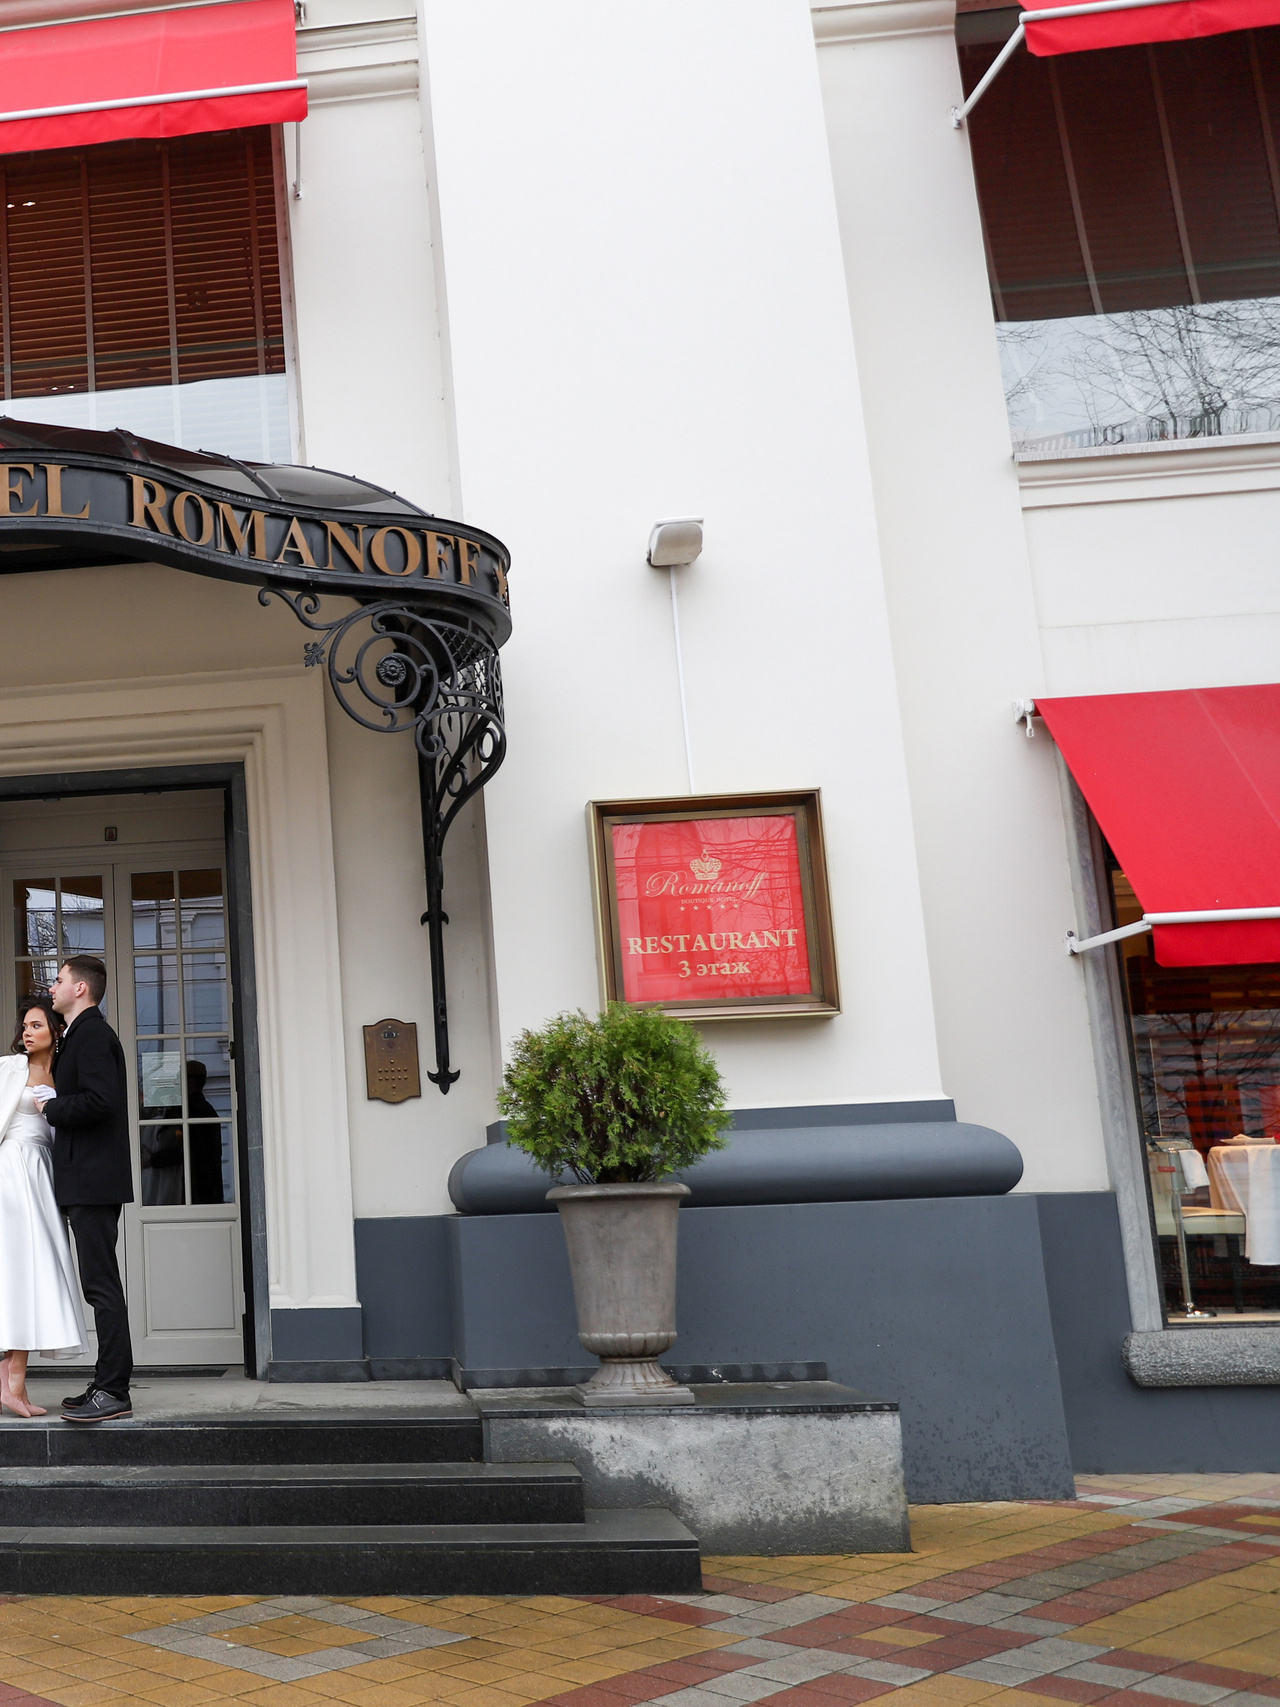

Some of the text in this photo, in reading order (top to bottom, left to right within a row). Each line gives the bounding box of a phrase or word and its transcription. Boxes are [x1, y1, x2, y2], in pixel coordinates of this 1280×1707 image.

[127, 473, 481, 586] ROMANOFF
[646, 871, 767, 899] Romanoff
[627, 929, 798, 955] RESTAURANT
[678, 961, 751, 978] 3 этаж
